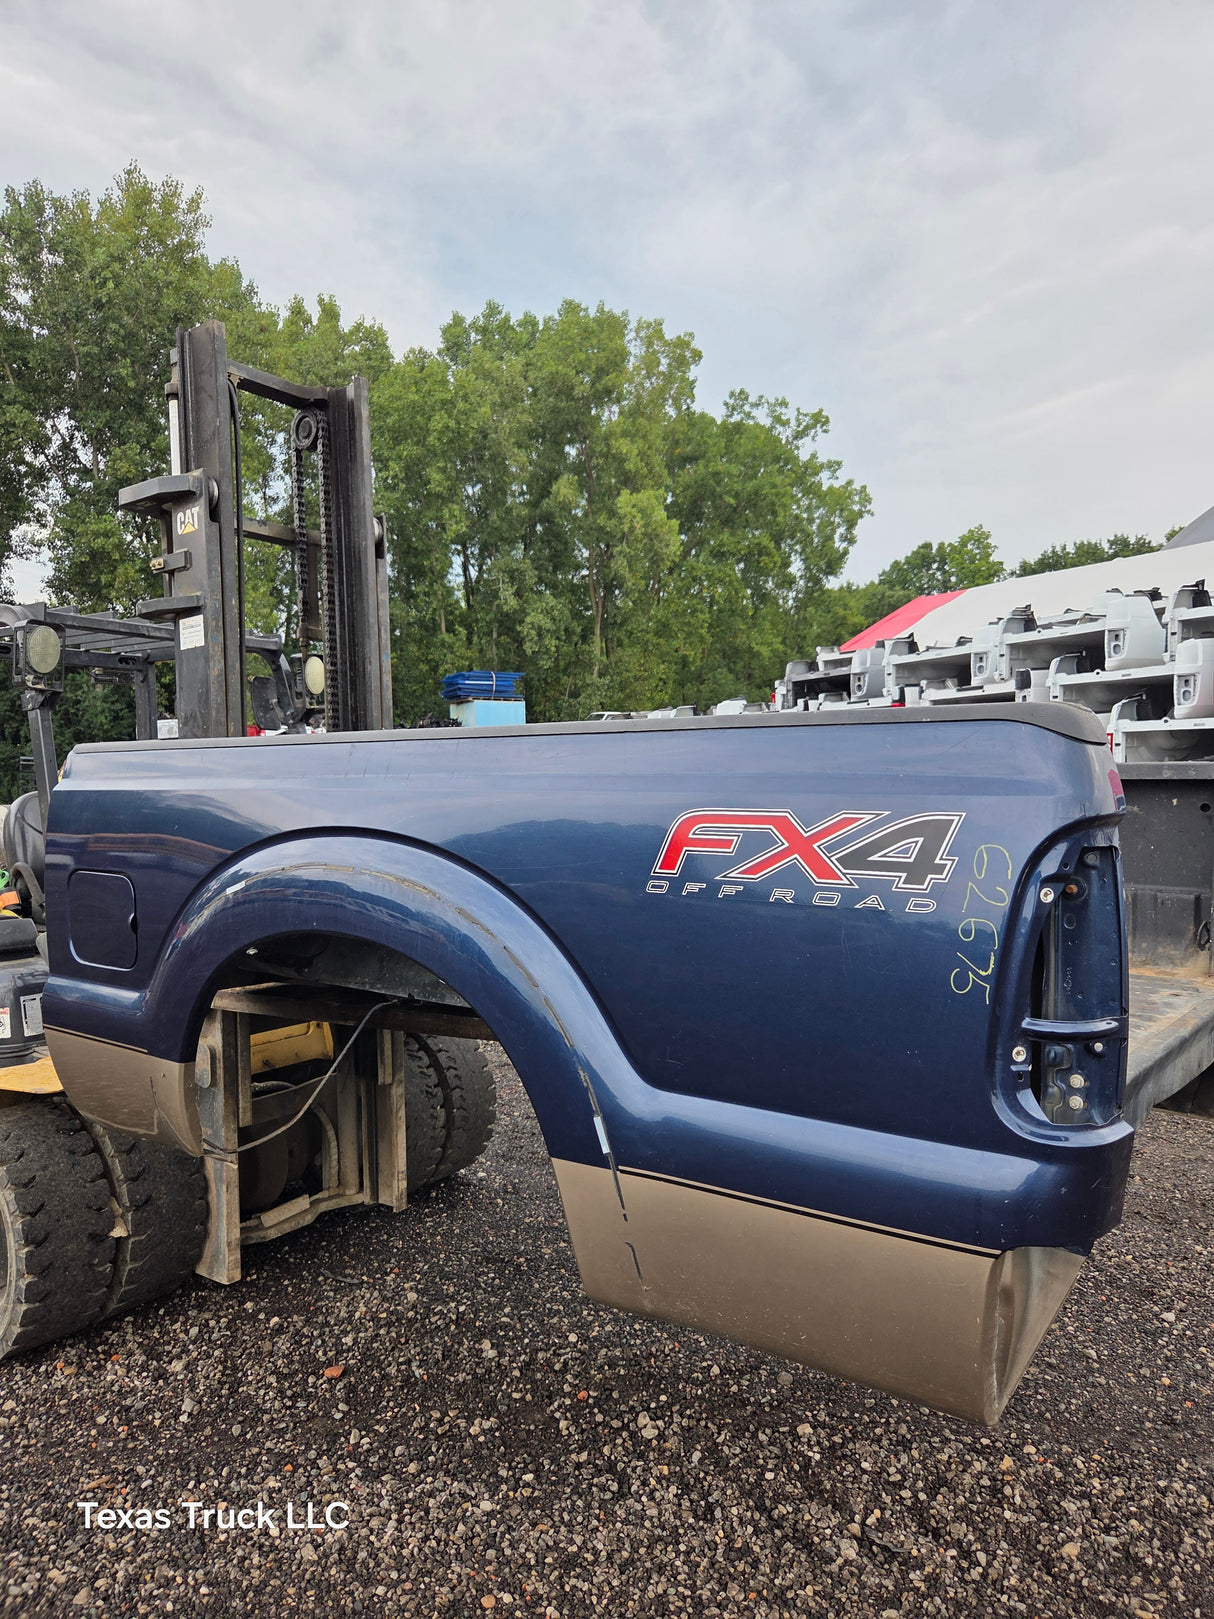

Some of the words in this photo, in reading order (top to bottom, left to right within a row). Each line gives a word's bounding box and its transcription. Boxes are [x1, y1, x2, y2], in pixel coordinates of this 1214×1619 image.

[177, 505, 200, 535] CAT
[651, 808, 966, 893] FX4
[646, 881, 744, 898] OFF
[769, 889, 937, 913] ROAD
[950, 843, 1012, 1005] 62675
